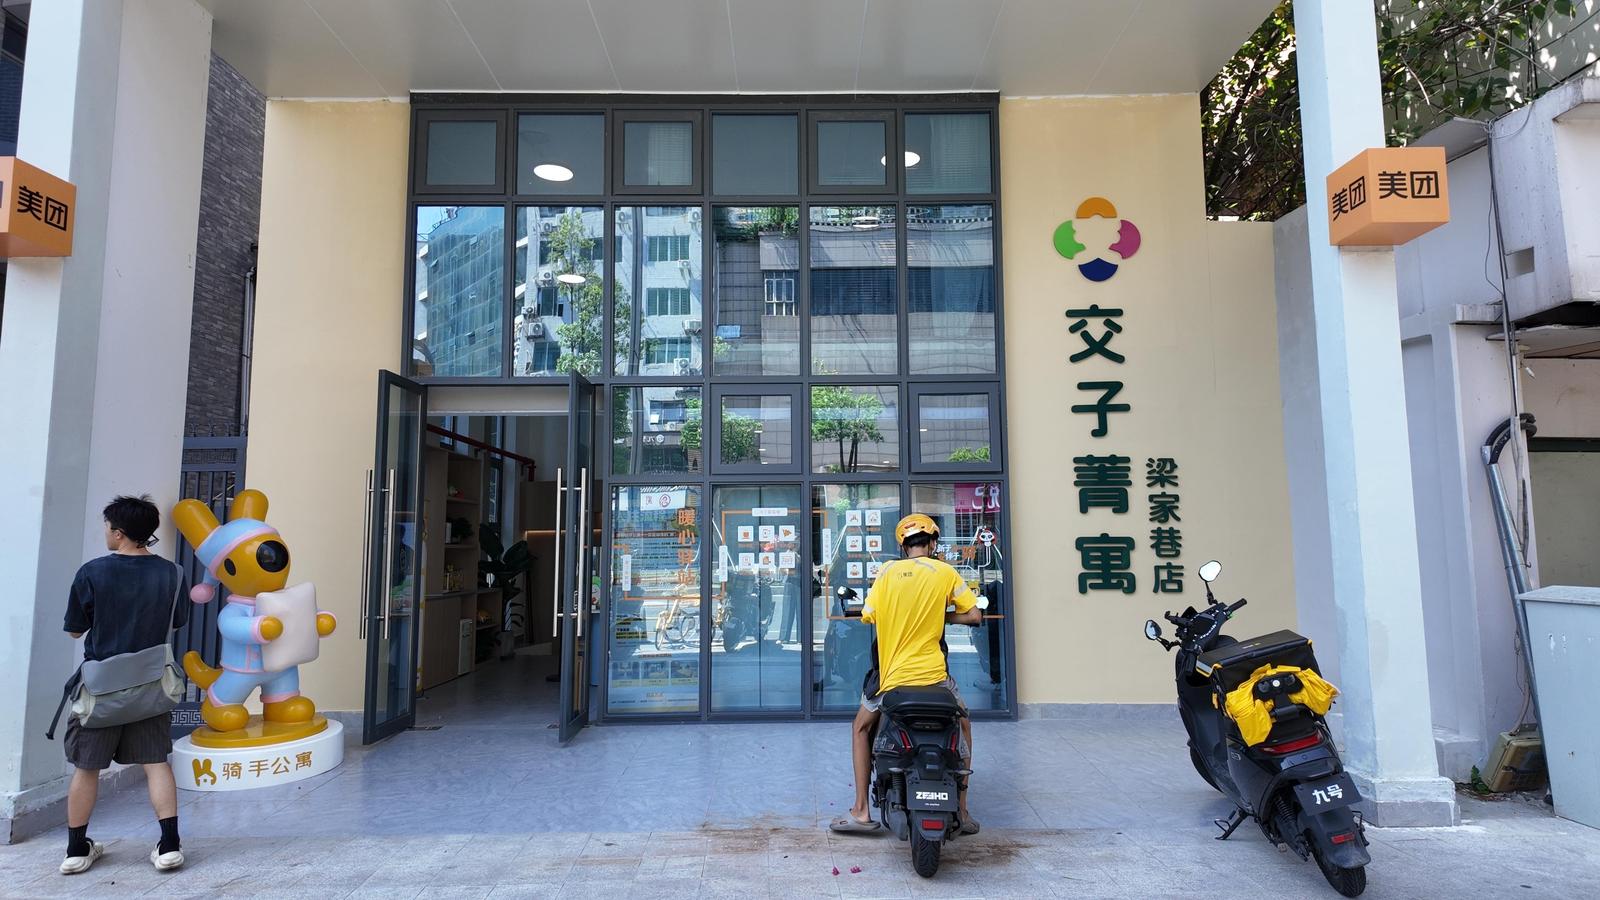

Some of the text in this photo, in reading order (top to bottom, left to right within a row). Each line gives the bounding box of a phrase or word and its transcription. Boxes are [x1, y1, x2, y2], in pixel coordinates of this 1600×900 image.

[1332, 176, 1366, 221] 美团
[1378, 171, 1440, 199] 美团
[17, 185, 68, 231] 美团
[1065, 304, 1136, 594] 交子菁寓
[1146, 457, 1184, 594] 梁家巷店
[222, 751, 313, 781] 骑手公寓
[1312, 784, 1343, 805] 九号
